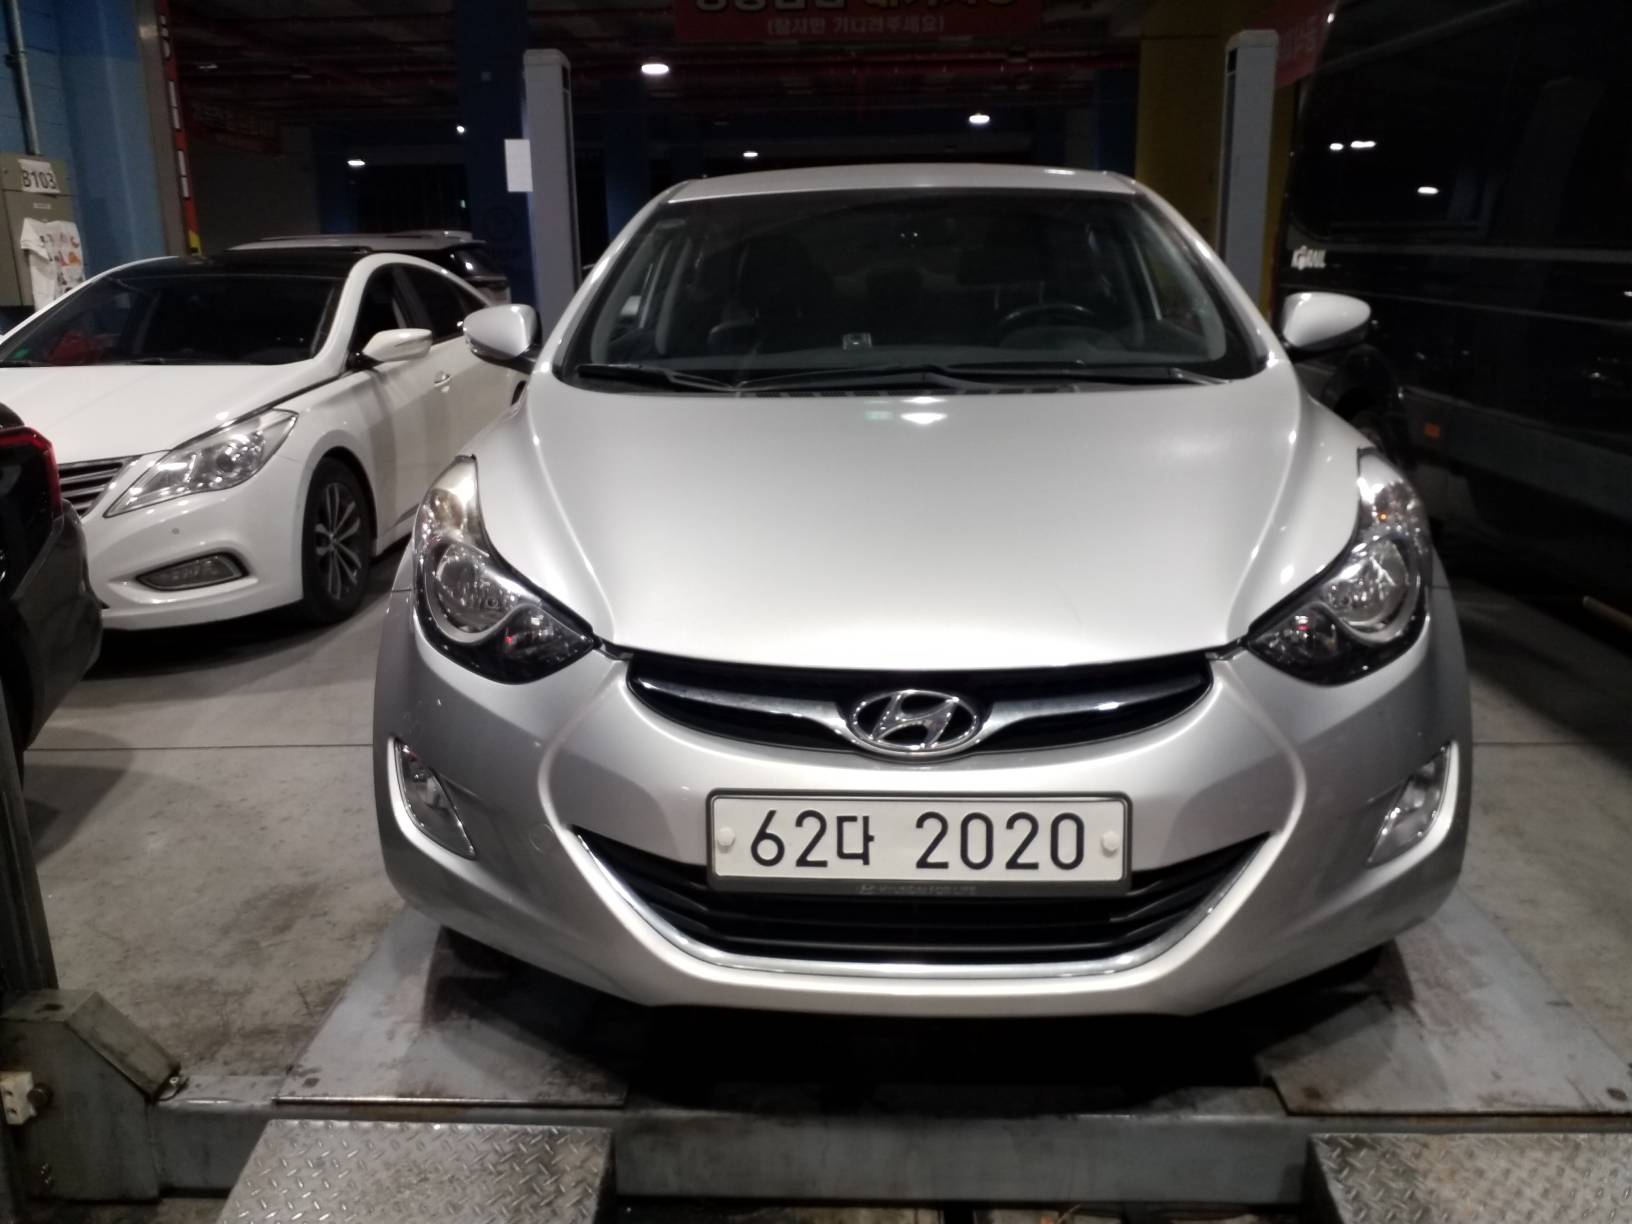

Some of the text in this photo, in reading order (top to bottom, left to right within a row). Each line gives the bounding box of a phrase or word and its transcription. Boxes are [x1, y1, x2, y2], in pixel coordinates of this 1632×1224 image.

[832, 15, 945, 34] 기다려주세요)
[750, 809, 1085, 870] 62다 2020
